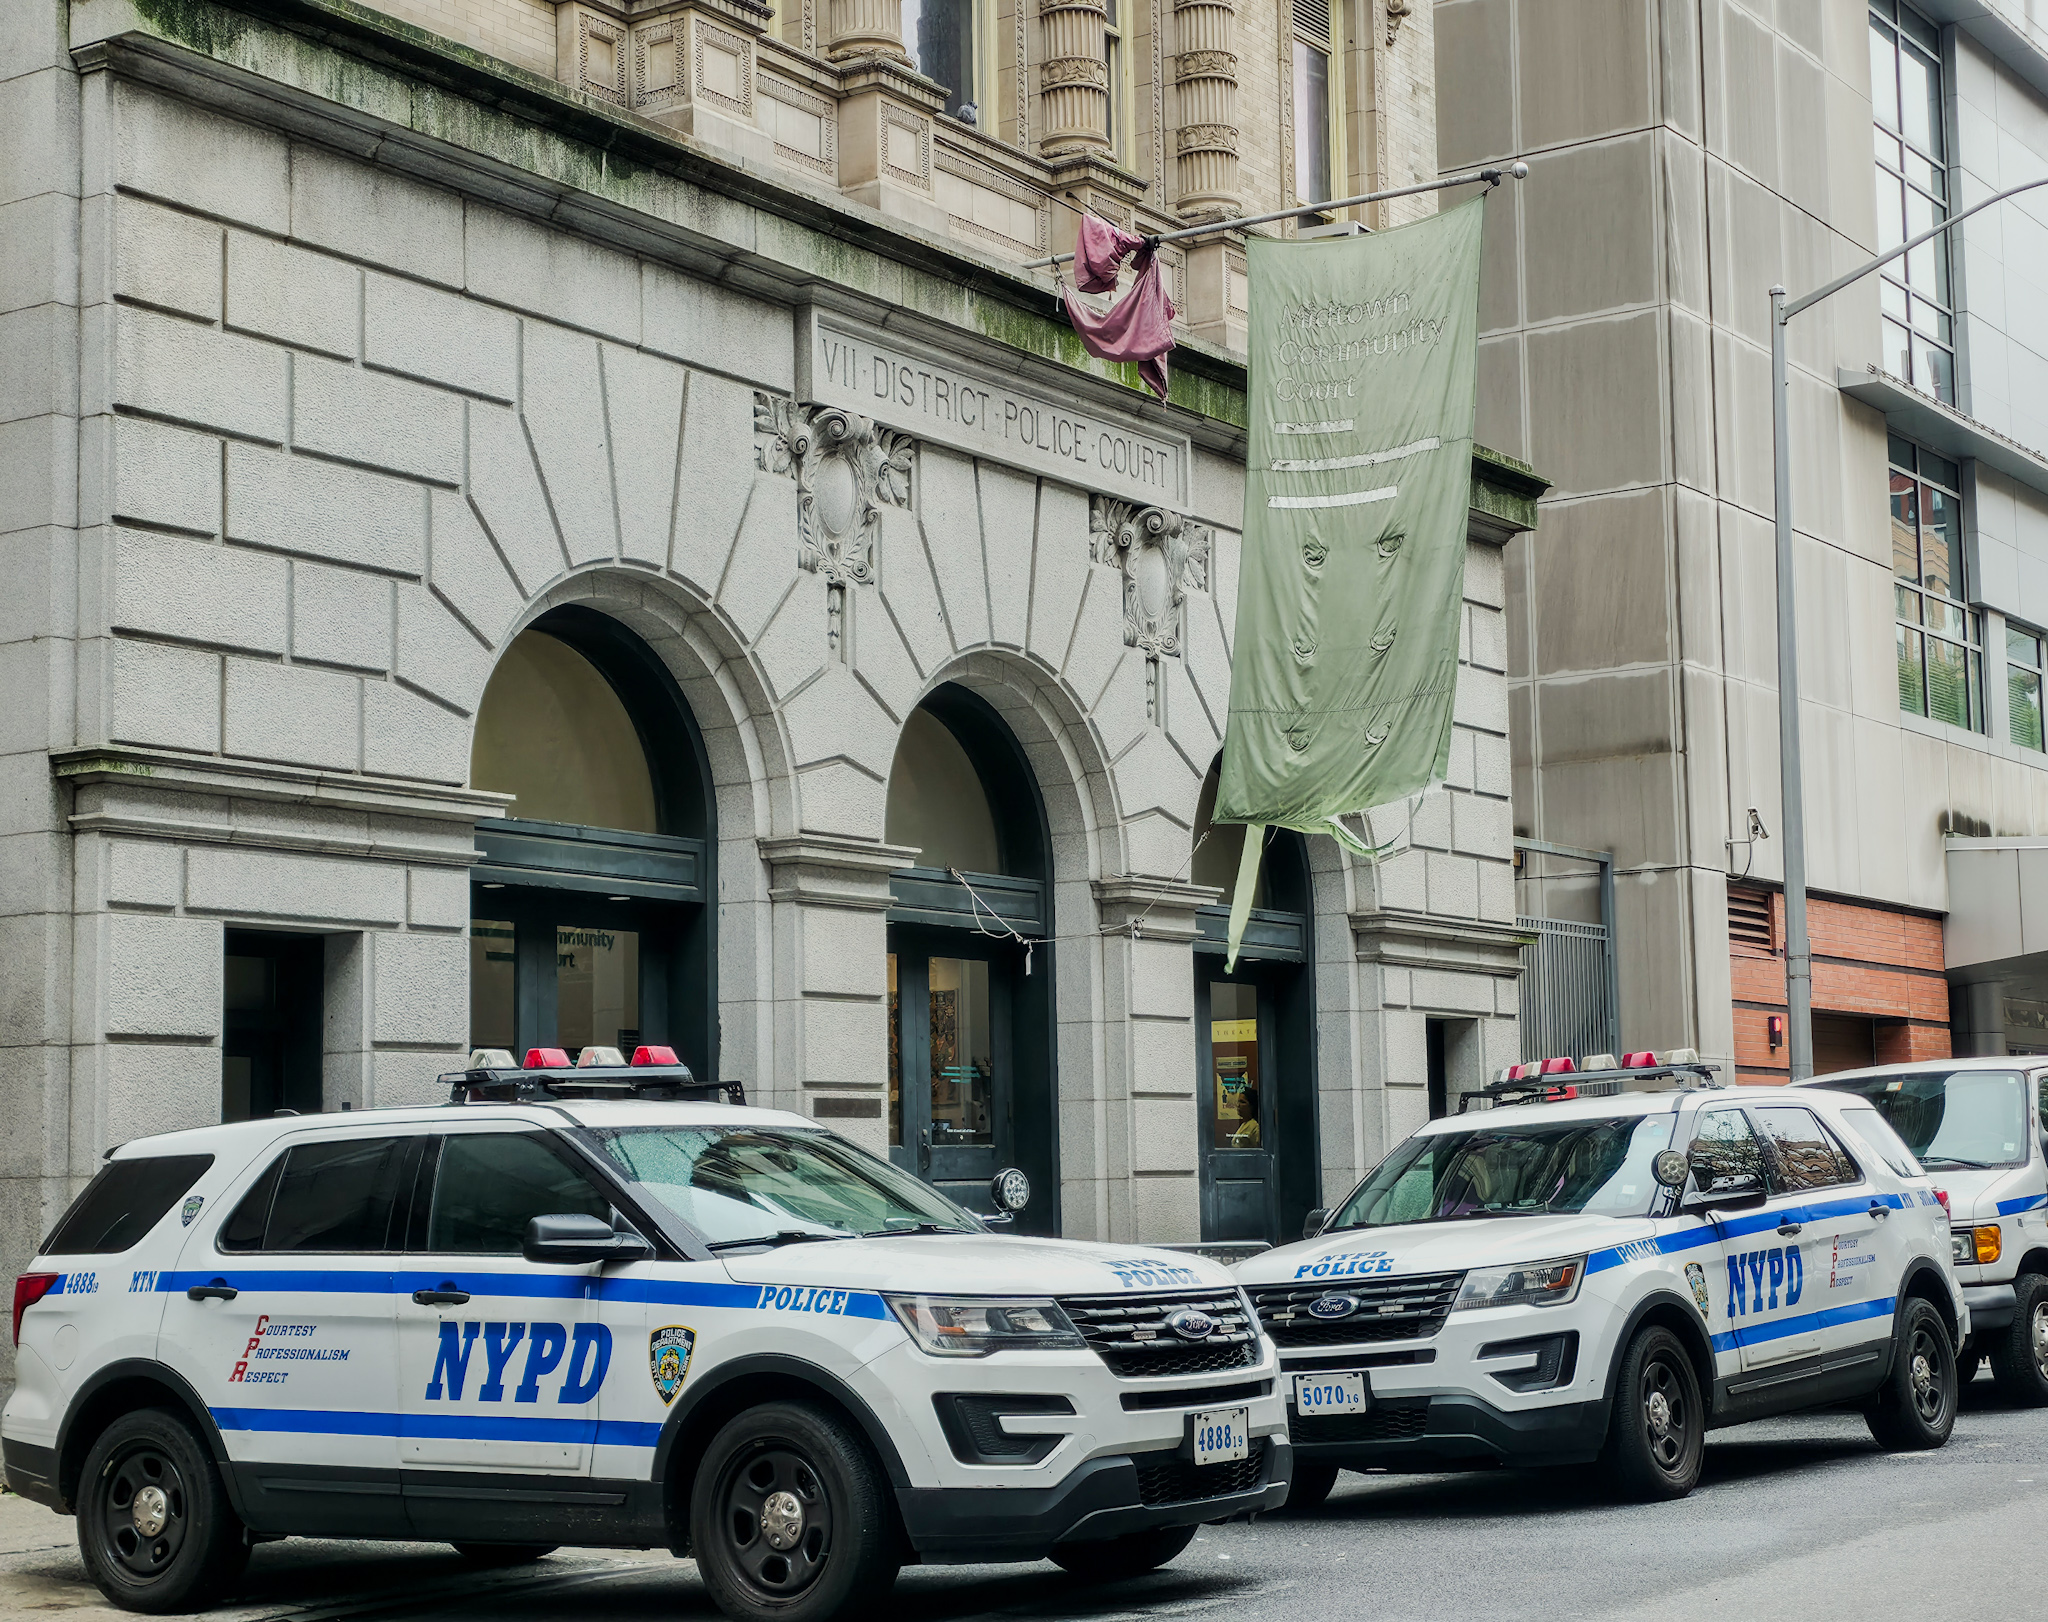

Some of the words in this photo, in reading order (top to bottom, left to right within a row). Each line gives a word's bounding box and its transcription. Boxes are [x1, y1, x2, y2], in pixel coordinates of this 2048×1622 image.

[1280, 292, 1410, 329] Midtown
[1278, 316, 1448, 367] Community
[1275, 375, 1356, 402] Court
[822, 338, 857, 390] VII
[873, 355, 990, 432] DISTRICT
[1004, 400, 1087, 463] POLICE
[1099, 433, 1168, 488] COURT
[1317, 1251, 1387, 1262] NYPD
[1618, 1238, 1661, 1264] POLICE
[1102, 1259, 1168, 1269] NYPD
[1294, 1258, 1394, 1279] POLICE
[128, 1271, 158, 1293] MTN
[1112, 1268, 1202, 1288] POLICE
[1727, 1244, 1804, 1318] NYPD
[759, 1286, 848, 1315] POLICE
[1318, 1300, 1343, 1312] Ford
[651, 1337, 692, 1351] DEPARTMENT
[661, 1329, 687, 1339] POLICE
[425, 1321, 613, 1404] NYPD
